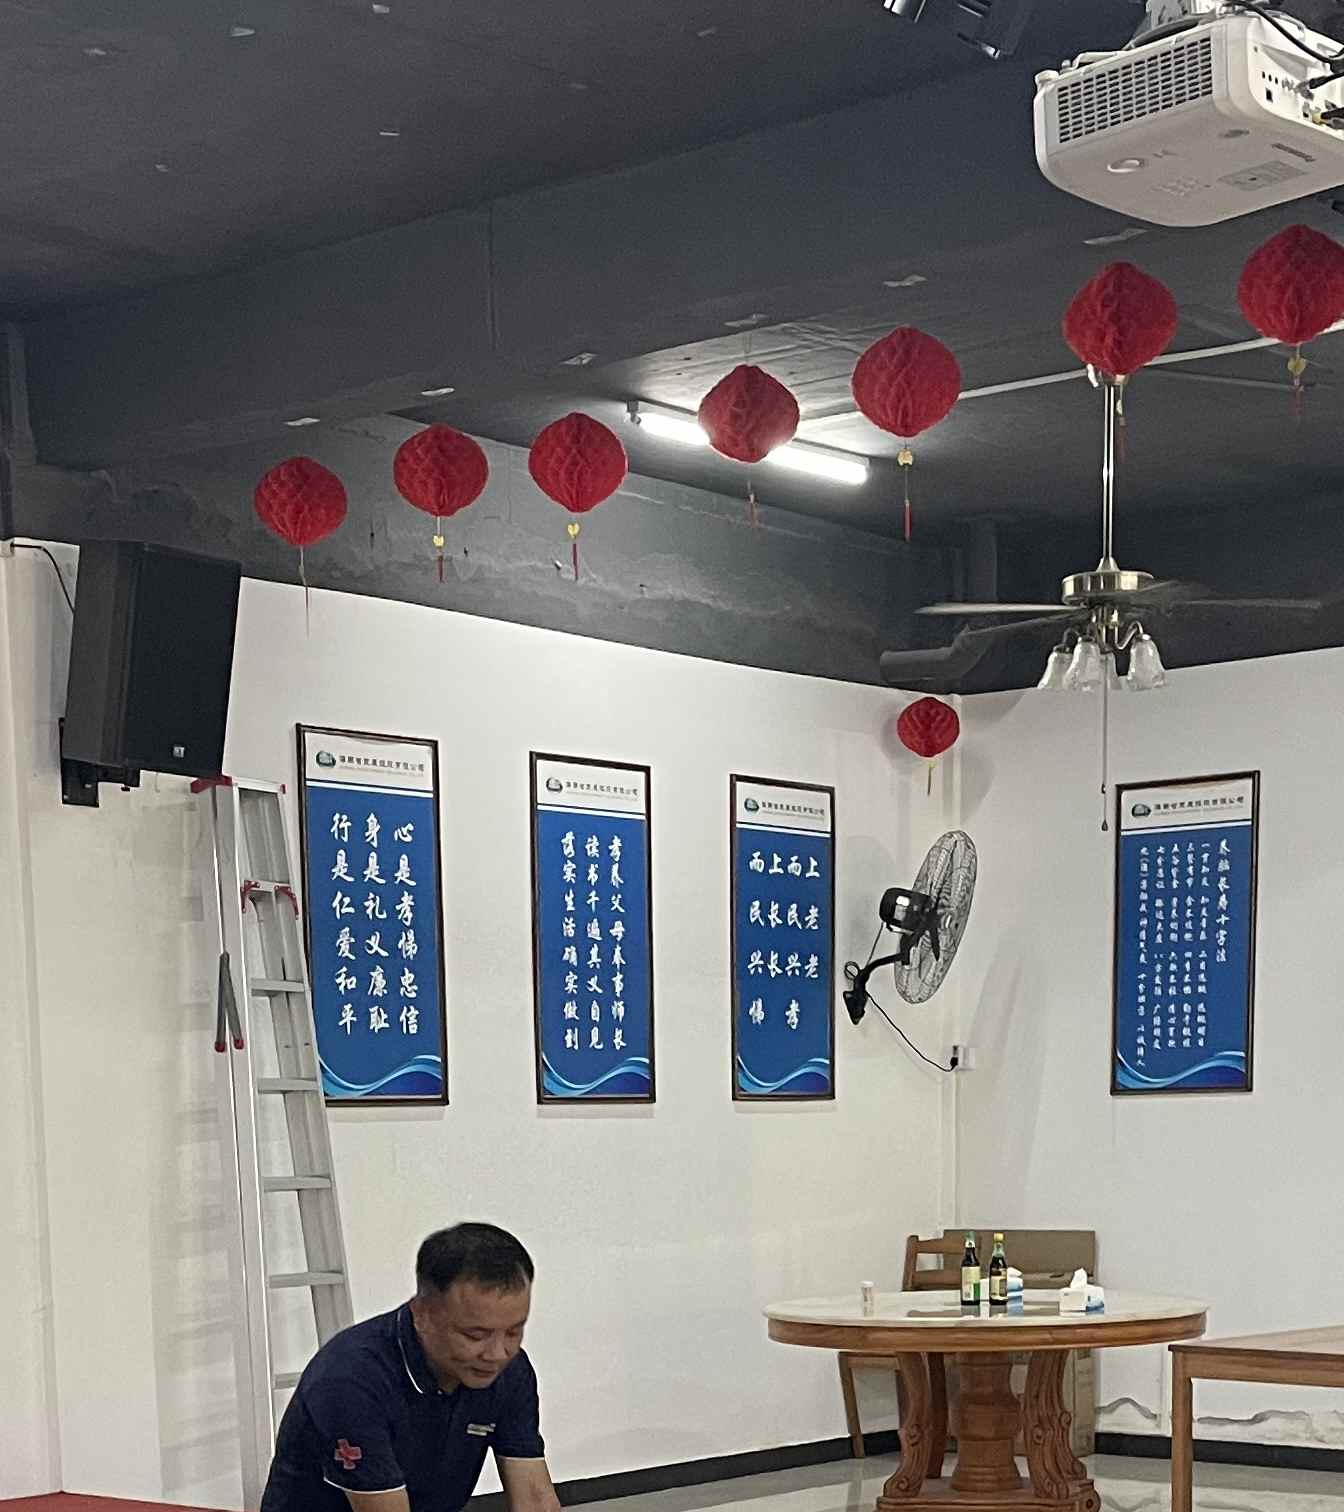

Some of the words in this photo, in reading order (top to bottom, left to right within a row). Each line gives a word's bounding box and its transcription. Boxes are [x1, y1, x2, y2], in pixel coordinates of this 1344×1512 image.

[330, 812, 357, 1035] 行是仁爱和平
[363, 812, 390, 1033] 身是礼义廉耻
[393, 823, 420, 1034] 心是孝悌忠信
[561, 831, 580, 1050] 落实生活确实做到
[584, 834, 604, 1050] 读书千遍其义自见
